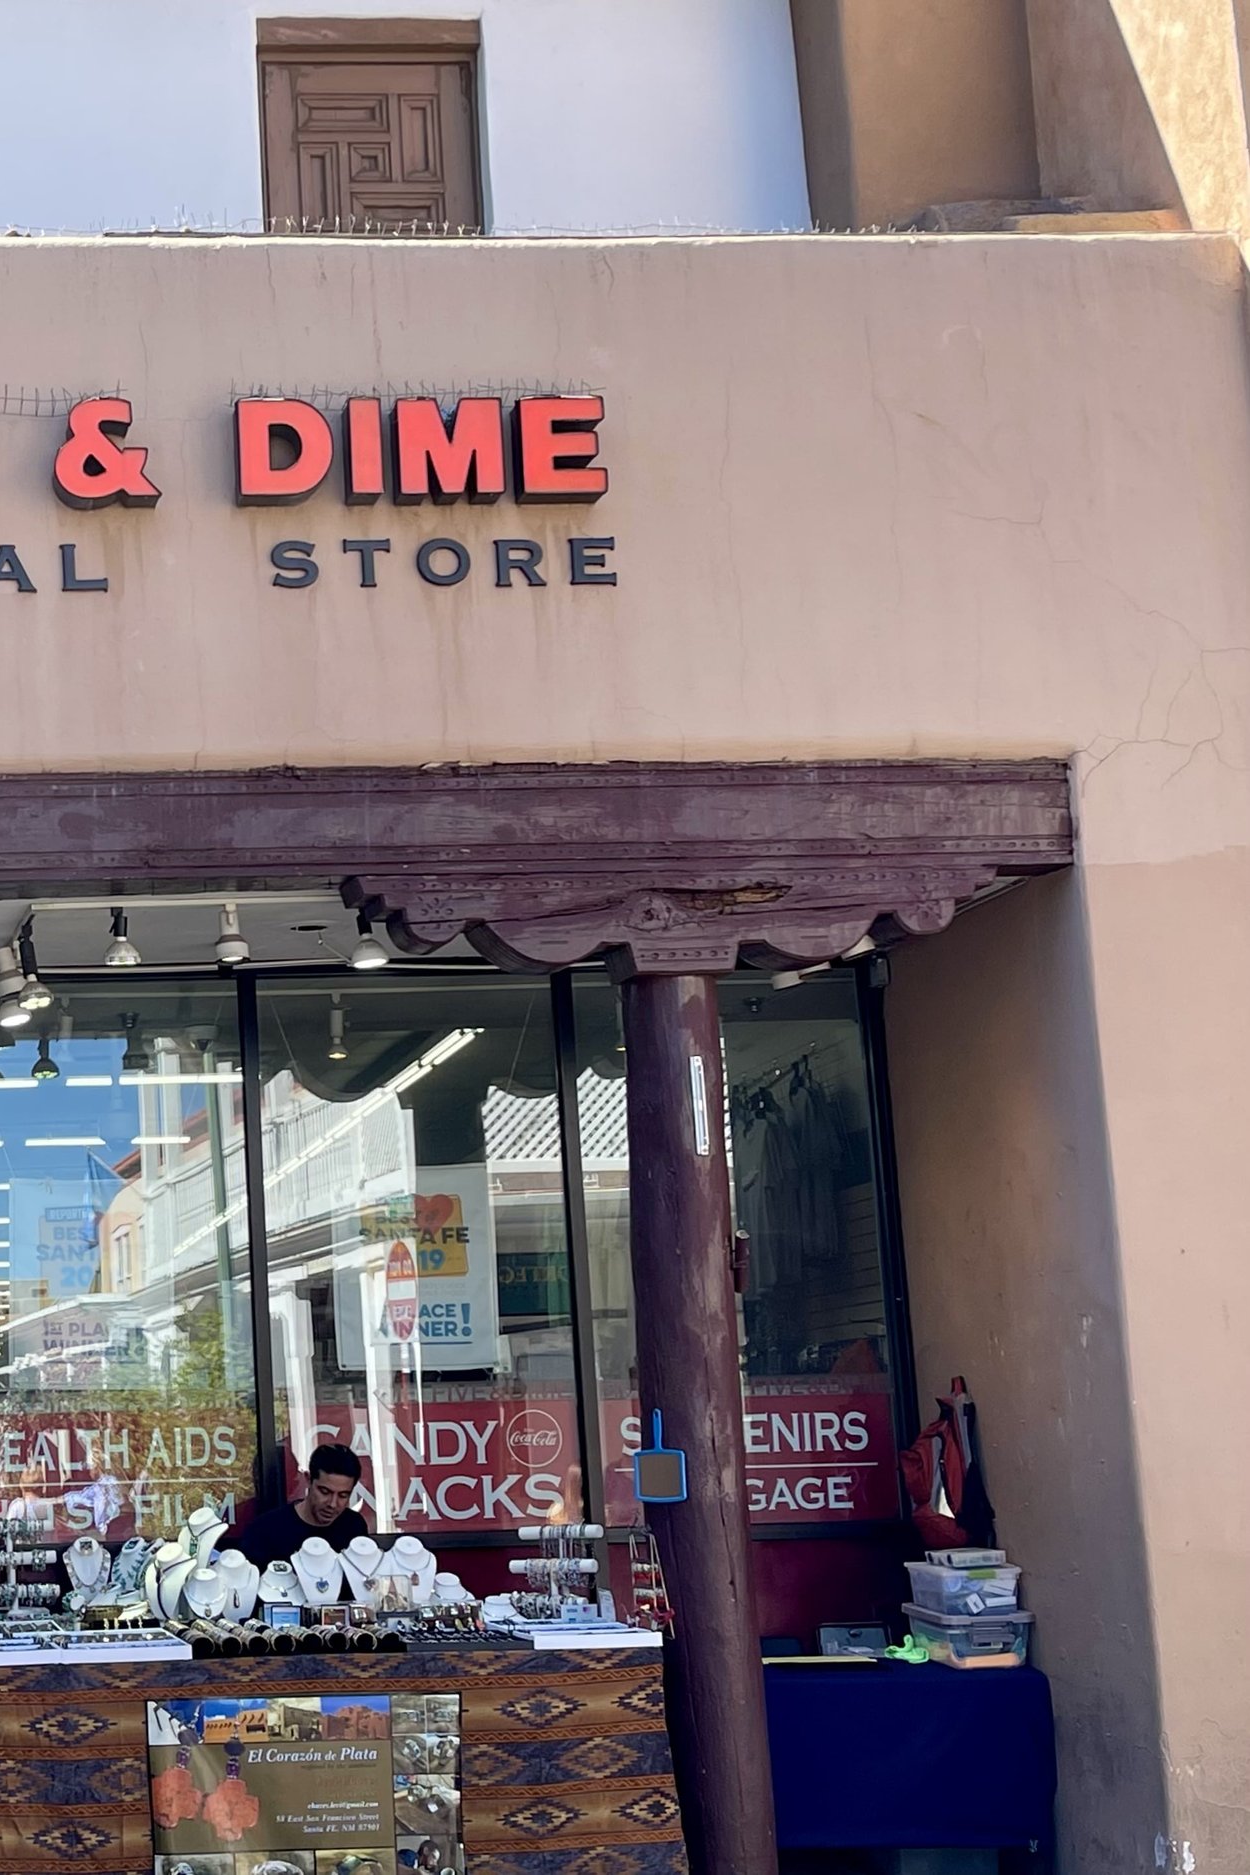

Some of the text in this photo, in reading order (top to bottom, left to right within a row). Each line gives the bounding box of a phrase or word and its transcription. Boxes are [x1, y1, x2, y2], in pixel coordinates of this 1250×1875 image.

[54, 397, 162, 509] &
[234, 395, 608, 507] DIME
[270, 537, 617, 588] STORE
[53, 1226, 90, 1241] BES
[441, 1226, 470, 1244] FE
[36, 1243, 95, 1262] SANT
[418, 1248, 446, 1271] 19
[60, 1265, 94, 1287] 20
[418, 1303, 457, 1318] ACE
[68, 1322, 109, 1337] PLA
[620, 1411, 869, 1456] SENIRS
[147, 1426, 237, 1468] AIDS
[350, 1473, 565, 1522] NACKS
[745, 1476, 854, 1511] GAGE
[134, 1492, 237, 1529] FILM
[247, 1746, 378, 1764] El Corazón de Plata
[287, 1814, 304, 1823] East
[306, 1814, 320, 1822] San
[358, 1812, 379, 1821] Street
[303, 1825, 323, 1834] Santa
